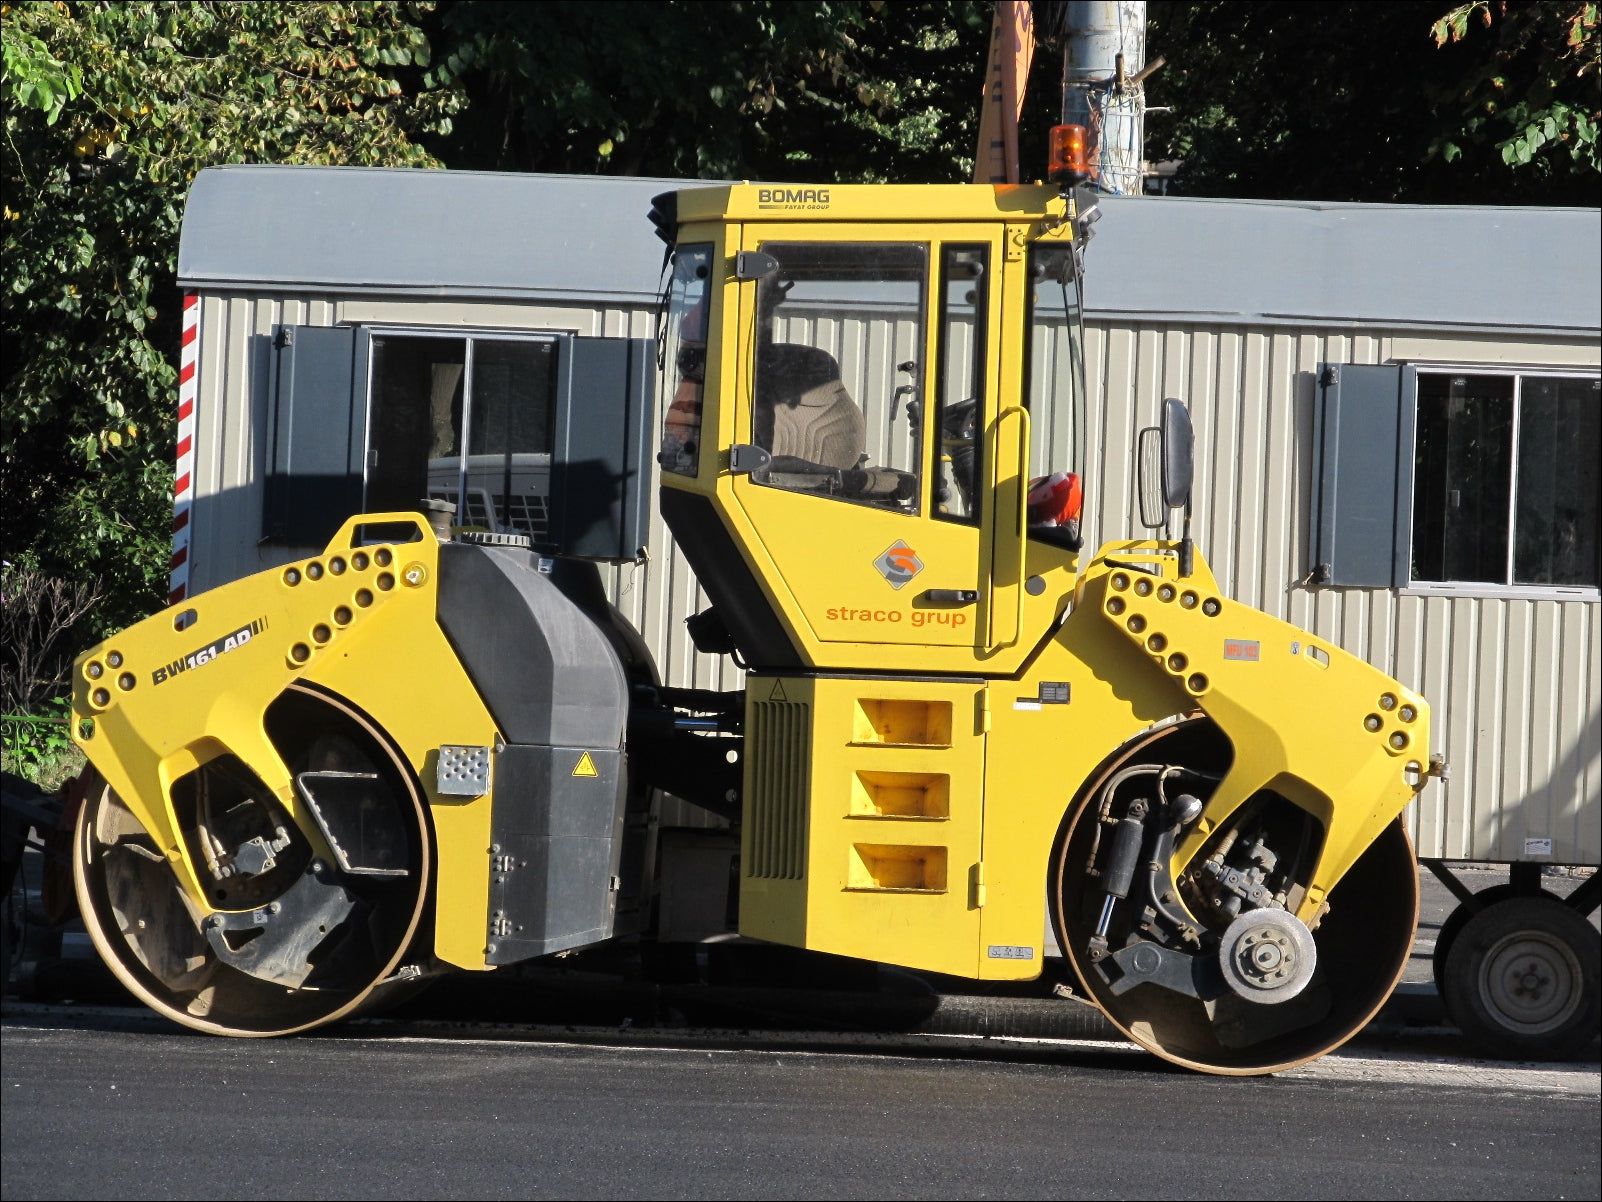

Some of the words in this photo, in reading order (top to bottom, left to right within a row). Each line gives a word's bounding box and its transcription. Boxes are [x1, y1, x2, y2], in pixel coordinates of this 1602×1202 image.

[759, 189, 830, 203] BOMAG
[826, 606, 902, 623] straco
[911, 611, 967, 628] grup
[224, 629, 252, 654] AD
